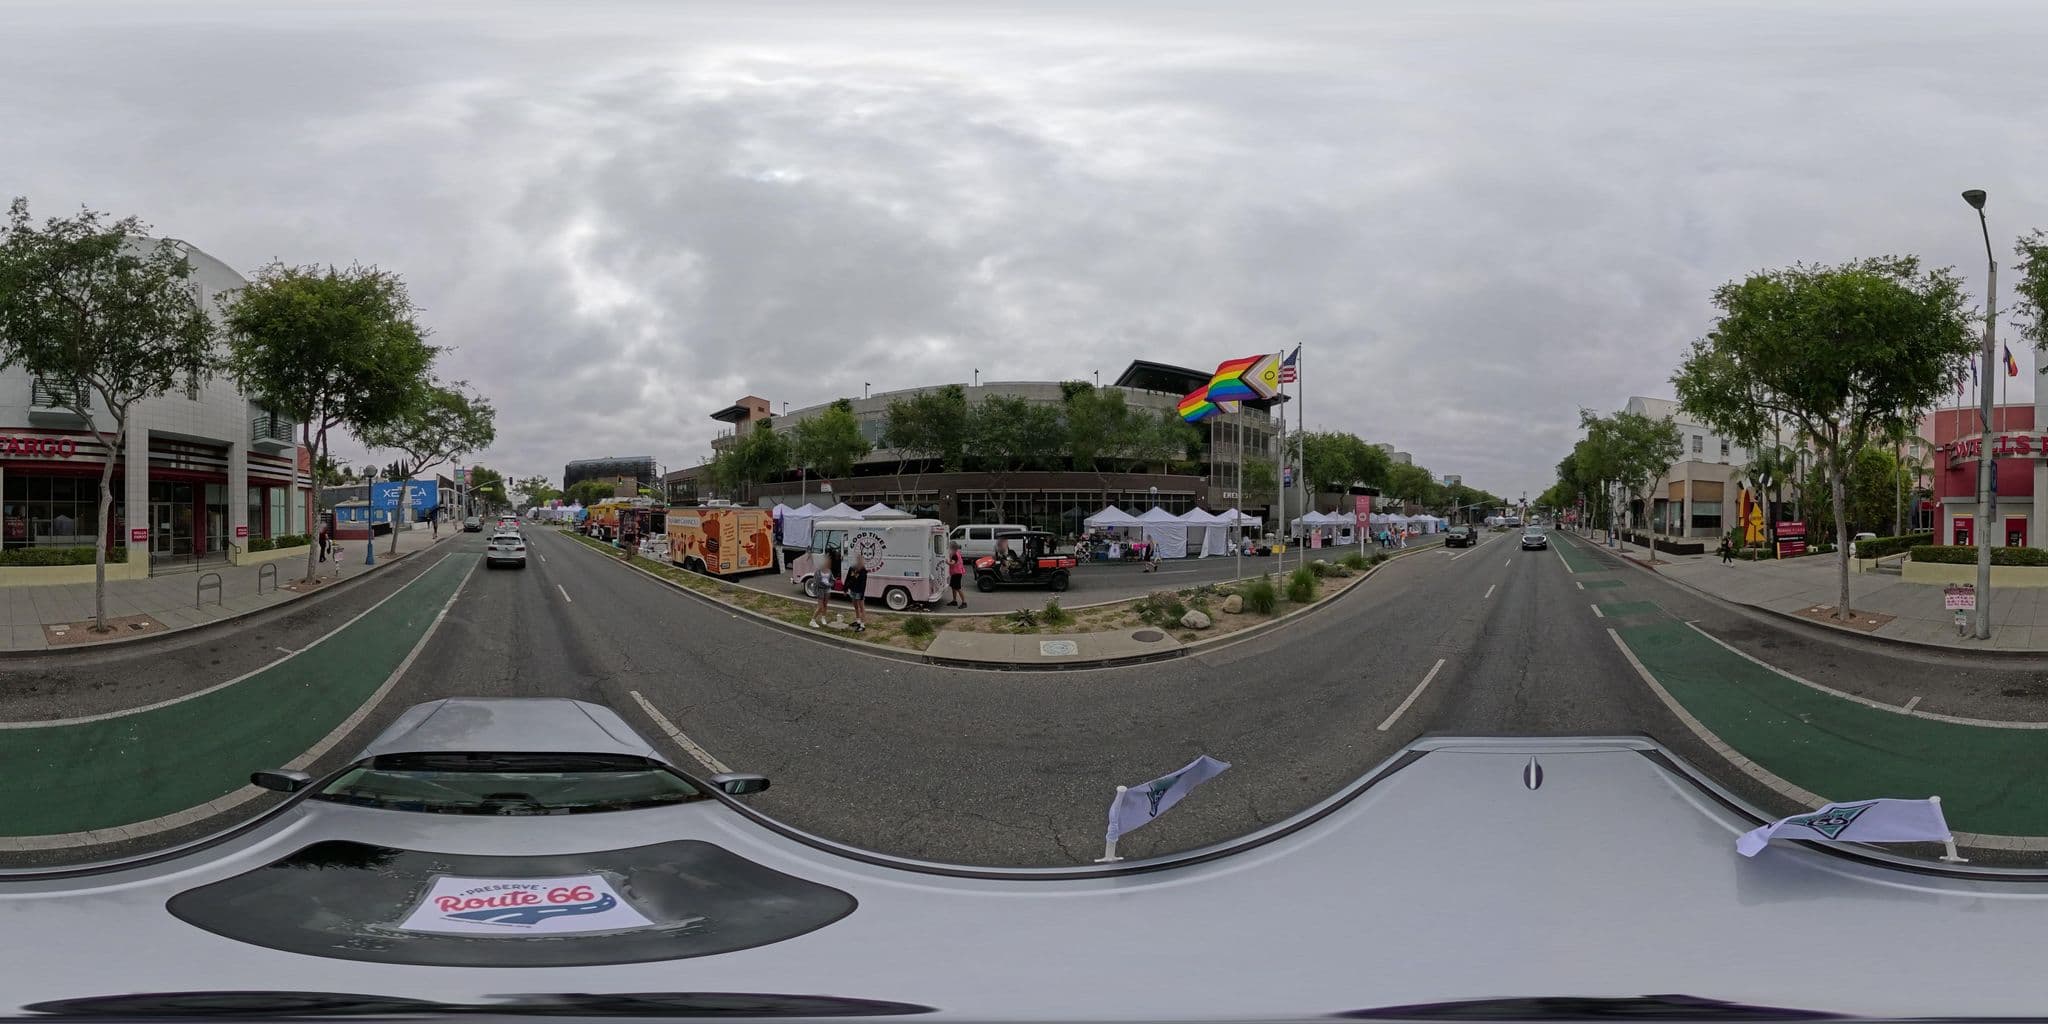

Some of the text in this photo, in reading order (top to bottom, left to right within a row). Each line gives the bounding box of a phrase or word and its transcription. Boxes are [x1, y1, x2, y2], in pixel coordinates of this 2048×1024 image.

[850, 532, 887, 550] GOOD TIMES
[465, 884, 540, 895] PRESERVE
[435, 886, 595, 912] Route 66
